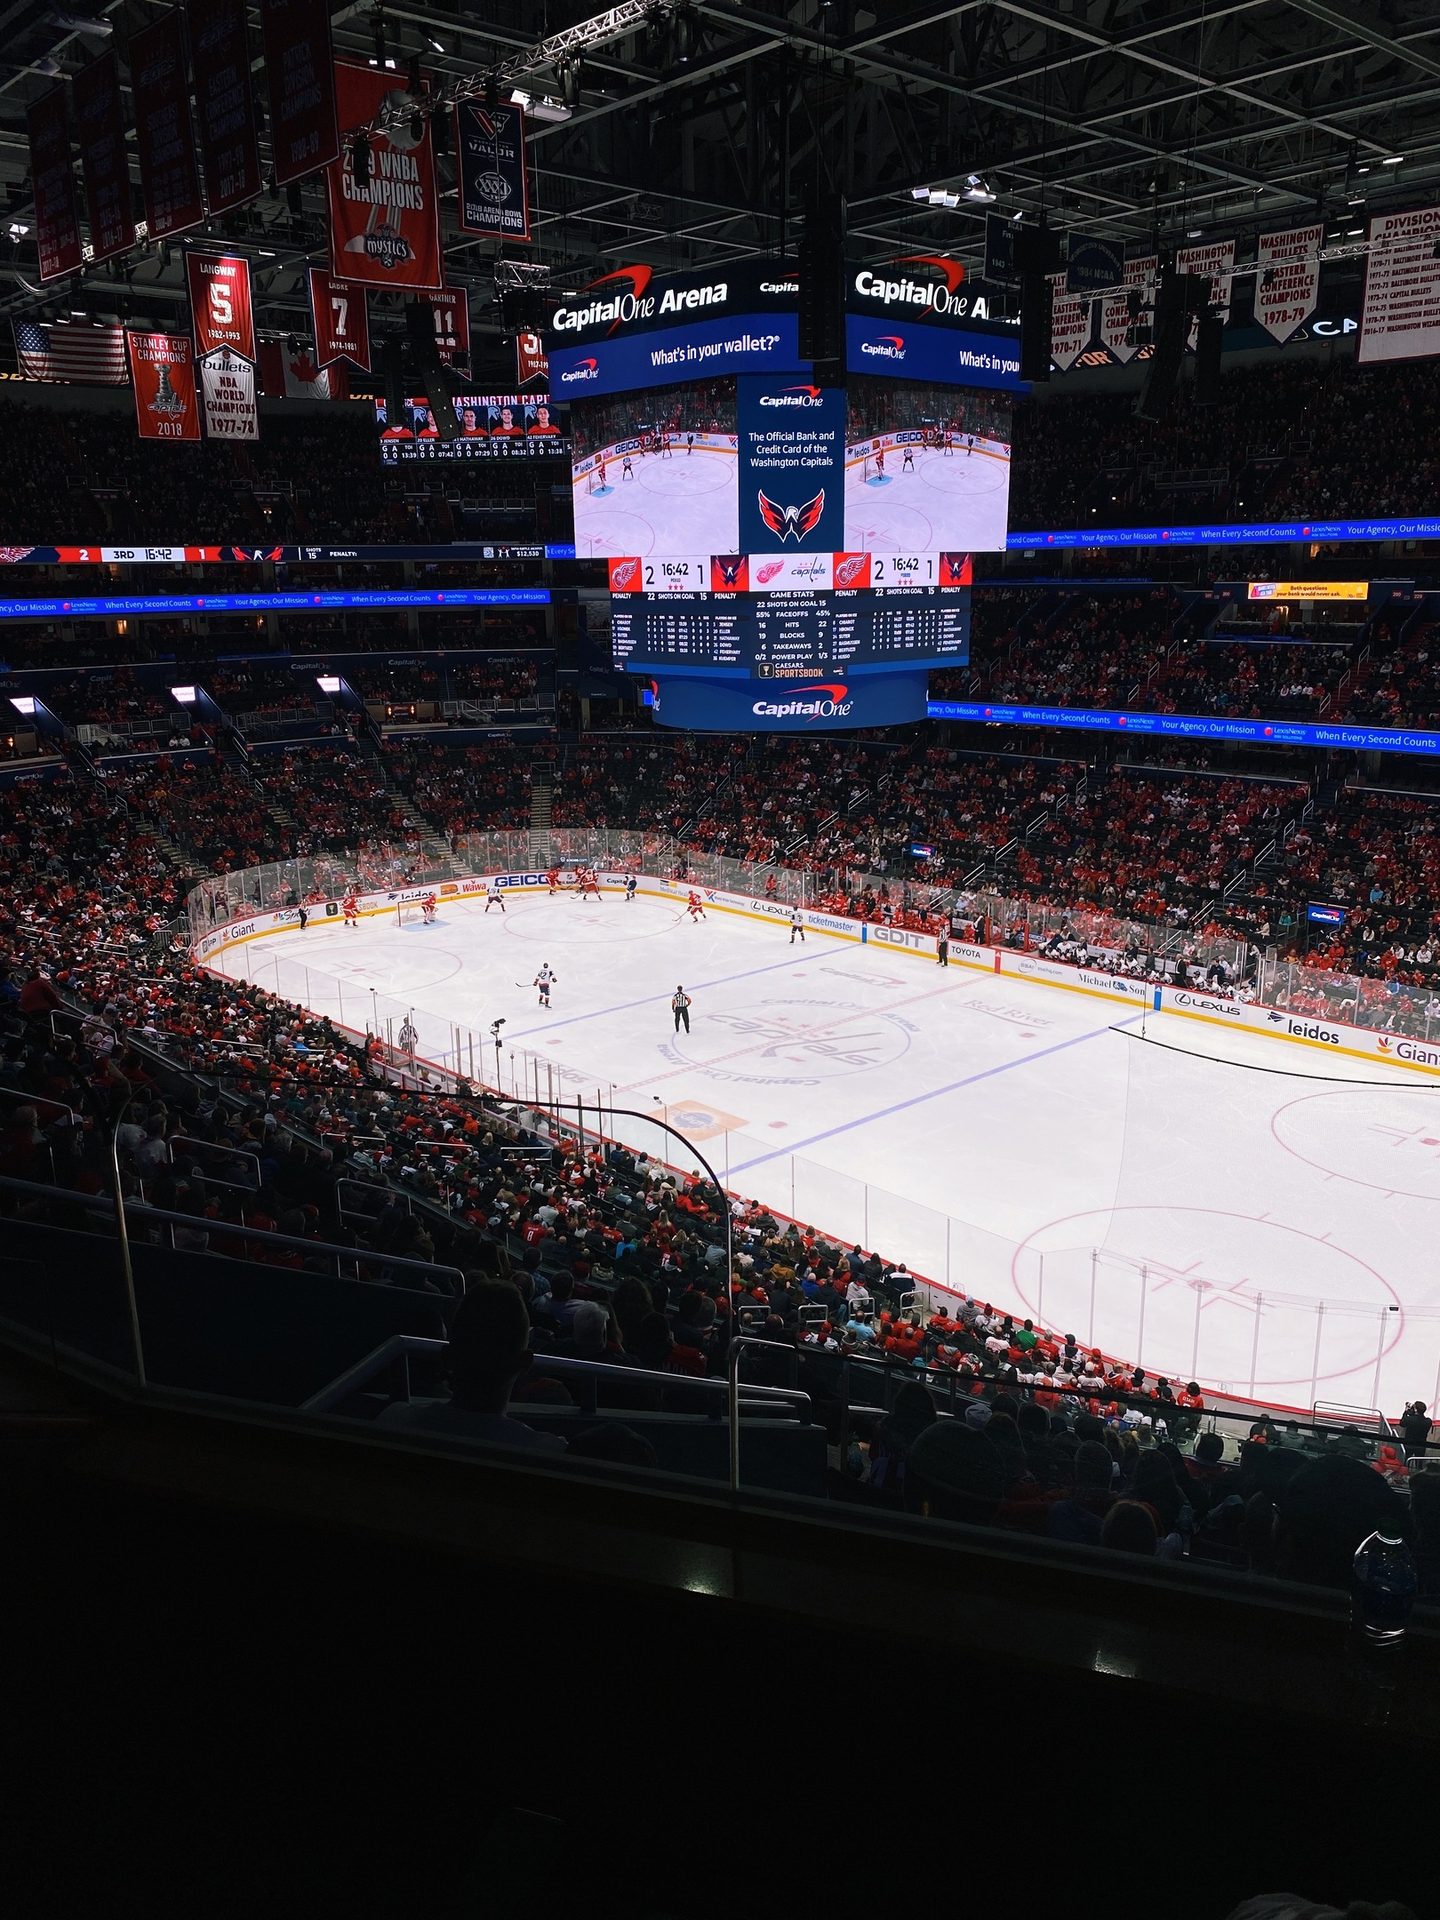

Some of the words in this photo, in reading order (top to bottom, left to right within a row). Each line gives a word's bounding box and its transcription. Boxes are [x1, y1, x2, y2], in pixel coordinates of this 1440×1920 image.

[468, 142, 514, 158] VALOR
[379, 151, 419, 182] WNBA
[342, 173, 424, 210] CHAMPIONS
[466, 203, 482, 212] 2018
[504, 209, 523, 218] BOWL
[466, 210, 523, 228] CHAMPIONS
[1260, 228, 1321, 249] WASHINGTON
[367, 239, 408, 257] mystics
[1178, 243, 1234, 264] WASHINGTON
[1271, 245, 1308, 259] BULLETS
[200, 264, 236, 277] LANGWAY
[1260, 275, 1314, 293] CONFERENCE
[659, 283, 728, 314] Arena
[1260, 289, 1311, 306] CHAMPIONS
[1390, 289, 1409, 299] CAPITAL
[1411, 287, 1432, 296] BULLETS
[210, 283, 233, 325] 5
[1389, 300, 1423, 310] WASHINGTON
[331, 297, 349, 336] 7
[1264, 307, 1305, 325] 1978-79
[1388, 311, 1422, 321] WASHINGTON
[433, 309, 456, 347] 11
[1387, 322, 1421, 333] WASHINGTON
[132, 337, 169, 350] STANLEY
[172, 340, 188, 350] CUP
[138, 350, 187, 364] CHAMPIONS
[651, 347, 685, 366] What's
[687, 346, 697, 359] in
[698, 342, 722, 362] your
[960, 351, 990, 368] What's
[992, 355, 1000, 369] in
[202, 359, 252, 373] bullets
[220, 376, 238, 388] NBA
[215, 389, 245, 401] WORLD
[206, 401, 255, 414] CHAMPIONS
[157, 422, 182, 436] 2018
[211, 418, 255, 434] 1977-78
[748, 433, 764, 441] The
[766, 432, 794, 441] Official
[797, 432, 817, 440] Bank
[819, 431, 834, 440] and
[756, 445, 780, 454] Credit
[782, 445, 801, 453] Card
[803, 444, 812, 453] of
[814, 445, 828, 453] the
[750, 458, 799, 468] Washington
[801, 457, 833, 468] Capitals
[1202, 530, 1221, 538] When
[1222, 530, 1241, 538] Every
[1243, 529, 1268, 537] Second
[1270, 528, 1296, 536] Counts
[1347, 526, 1365, 534] Your
[1367, 525, 1398, 535] Agency,
[79, 549, 90, 561] 2
[113, 550, 135, 559] 3RD
[145, 548, 172, 560] 16:42
[645, 566, 655, 584] 2
[662, 563, 689, 576] 16:42
[697, 565, 704, 584] 1
[791, 556, 826, 583] capitals
[874, 561, 884, 580] 2
[892, 558, 919, 571] 16:42
[927, 560, 933, 580] 1
[875, 589, 884, 597] 22
[928, 587, 934, 595] 15
[775, 668, 823, 678] SPORTSBOOK
[1041, 712, 1059, 722] Every
[1061, 714, 1085, 722] Second
[1087, 715, 1110, 724] Counts
[1161, 720, 1179, 730] Your
[1180, 721, 1209, 733] Agency,
[1210, 724, 1224, 732] Our
[1226, 725, 1255, 734] Mission
[1274, 727, 1306, 735] LexisNexis
[1316, 731, 1340, 741] When
[1342, 732, 1367, 744] Every
[1368, 734, 1401, 745] Second
[1403, 737, 1436, 747] Counts
[463, 880, 487, 892] Wawa
[808, 914, 854, 932] ticketmaster
[231, 923, 255, 939] Giant
[874, 927, 924, 948] GDIT
[952, 946, 981, 959] TOYOTA
[1078, 974, 1111, 989] Michael
[1129, 985, 1146, 996] Son
[1192, 1000, 1241, 1016] LEXUS
[1005, 1007, 1054, 1026] River
[1288, 1019, 1339, 1044] leidos
